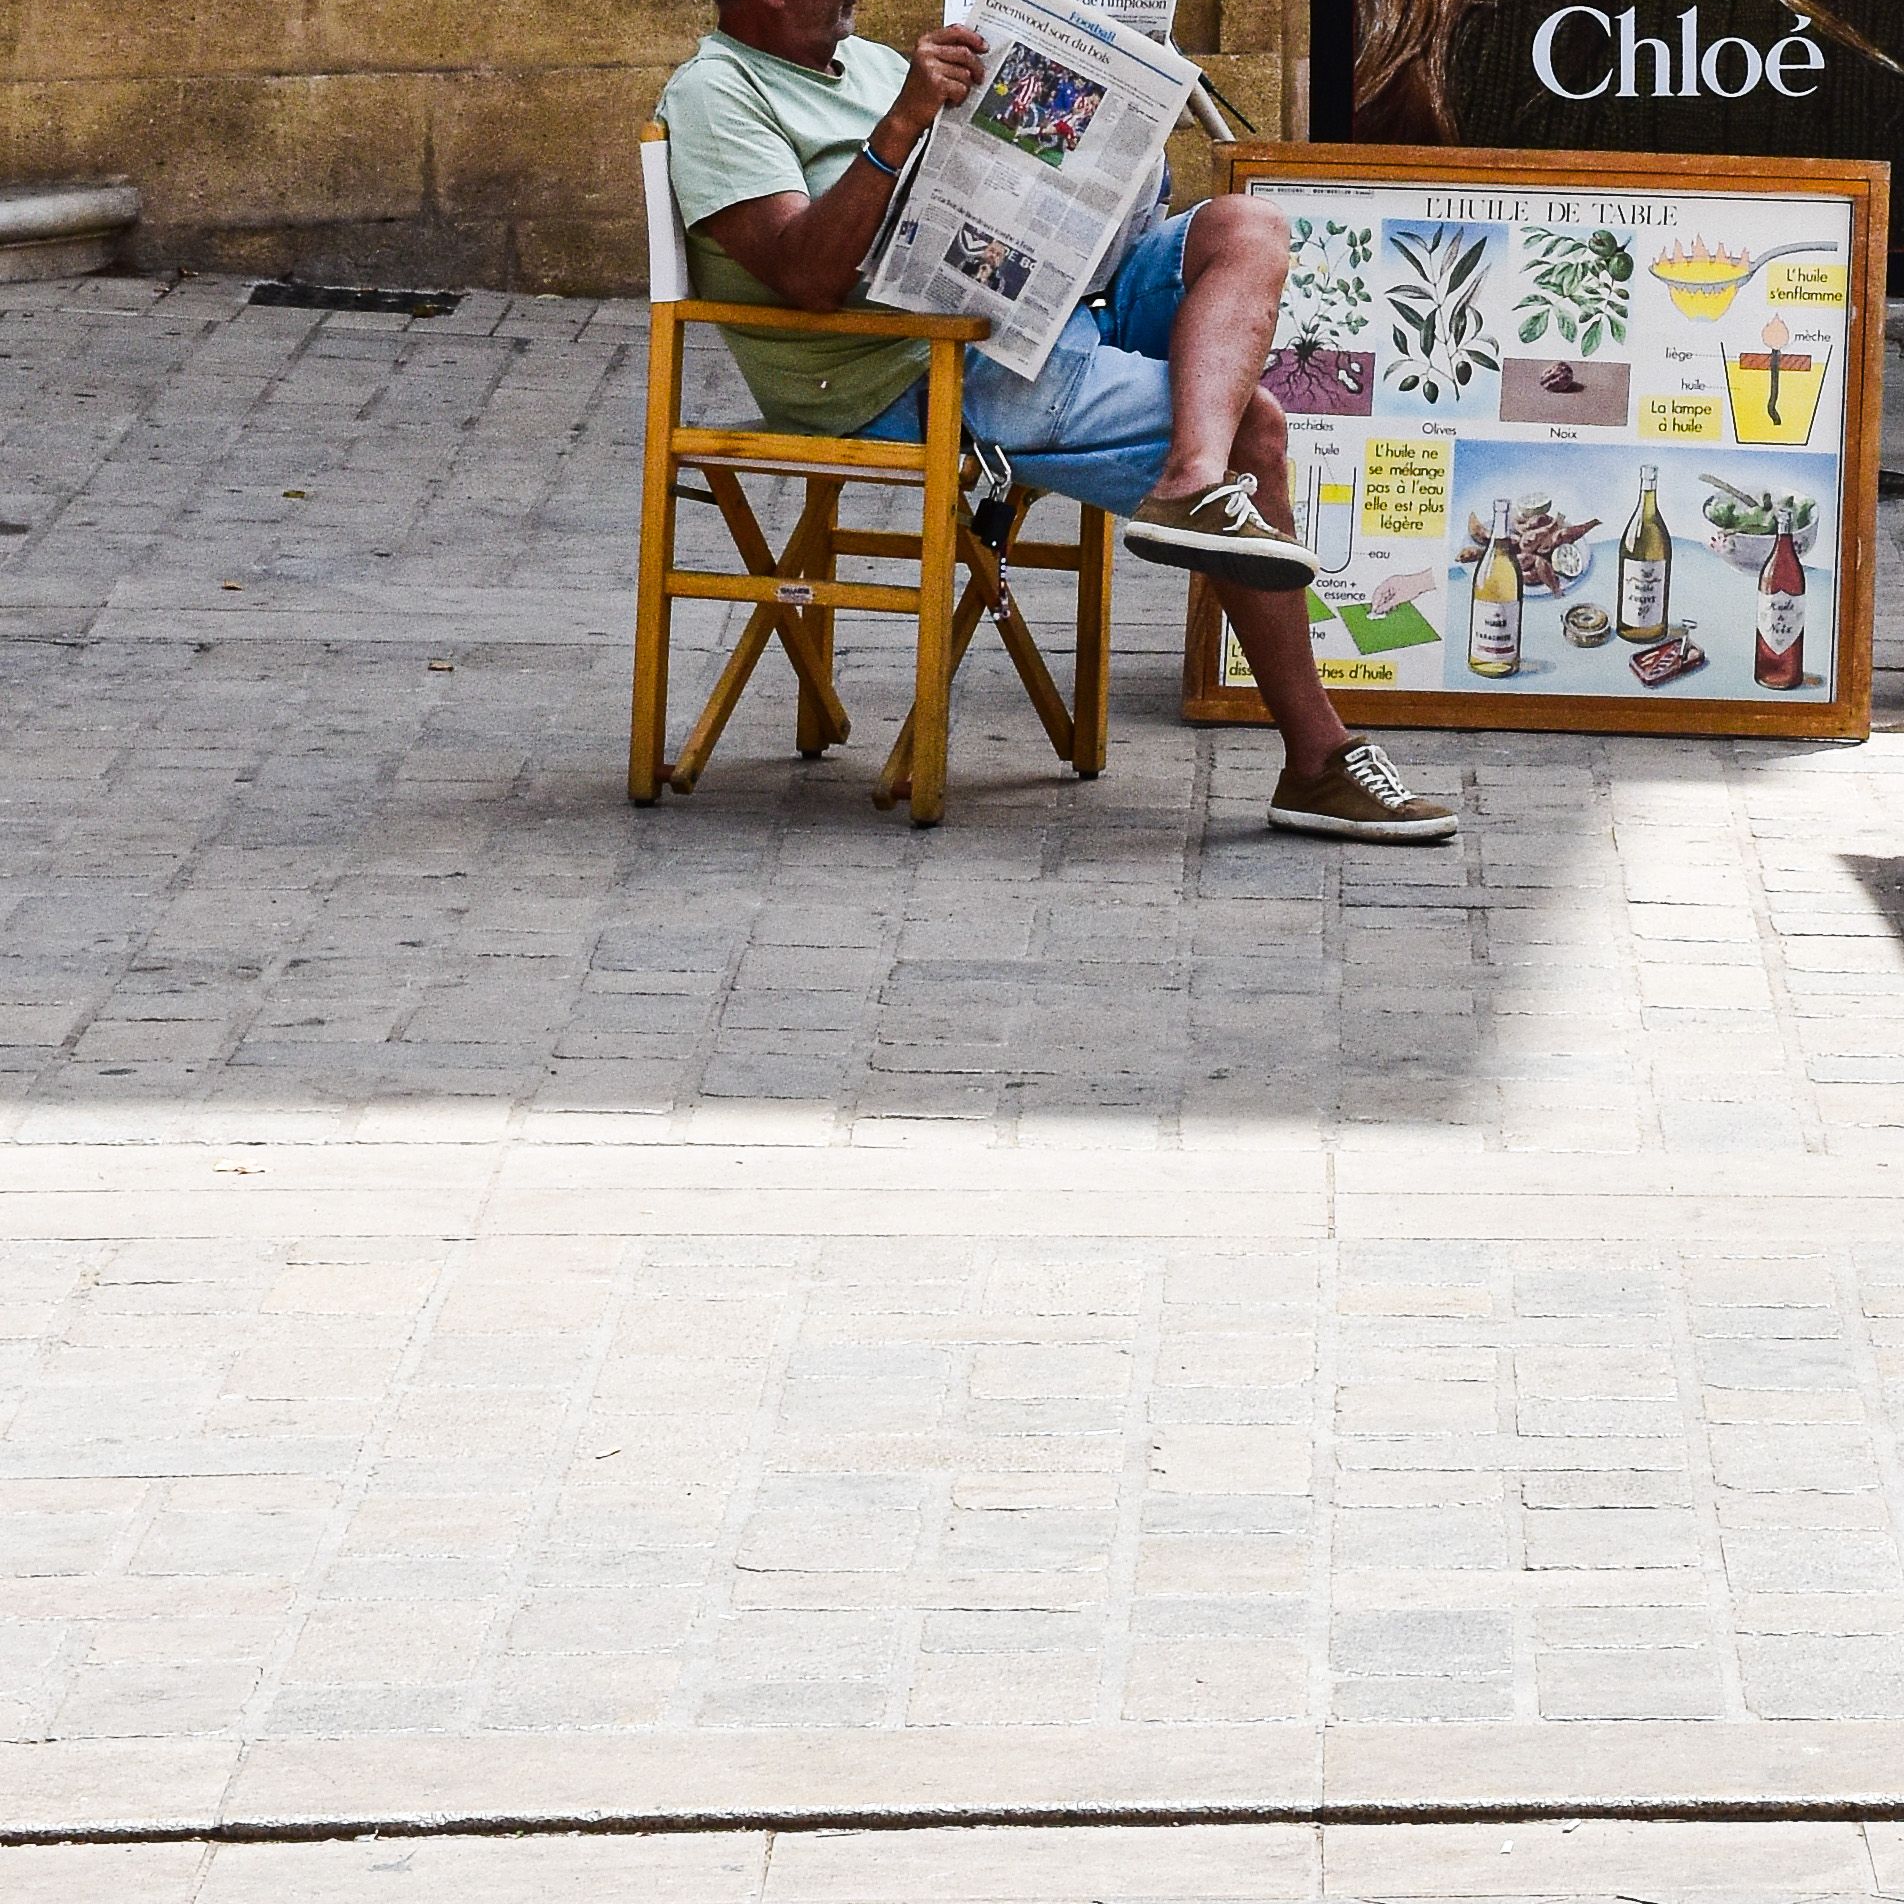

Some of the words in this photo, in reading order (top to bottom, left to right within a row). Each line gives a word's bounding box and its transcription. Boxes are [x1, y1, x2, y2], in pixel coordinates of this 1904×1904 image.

[1069, 11, 1117, 42] Football
[1050, 26, 1071, 44] sort
[1070, 35, 1088, 53] du
[1087, 43, 1112, 66] bois
[1531, 5, 1825, 100] Chloé
[1425, 196, 1530, 222] L'HUILE
[1547, 202, 1581, 224] DE
[1592, 203, 1679, 227] TABLE
[1787, 268, 1829, 284] L'huile
[1770, 286, 1844, 303] s'enflamme
[1794, 330, 1832, 343] mèche
[1665, 346, 1694, 363] liège
[1681, 378, 1706, 391] huile
[1651, 400, 1667, 414] La
[1671, 400, 1713, 417] lampe
[1421, 421, 1457, 436] Olives
[1549, 427, 1578, 440] Noix
[1658, 417, 1667, 433] à
[1672, 418, 1704, 434] huile
[1314, 443, 1340, 456] huile
[1375, 444, 1416, 459] L'huile
[1421, 449, 1439, 460] ne
[1368, 465, 1384, 476] se
[1389, 460, 1445, 481] mélange
[1366, 482, 1391, 497] pas
[1398, 479, 1407, 494] à
[1411, 479, 1444, 495] l'eau
[1364, 497, 1388, 511] elle
[1394, 499, 1413, 512] est
[1418, 499, 1445, 515] plus
[1380, 515, 1425, 534] légère
[1368, 549, 1391, 560] eau
[1316, 578, 1348, 589] coton
[1323, 591, 1366, 601] essence
[1349, 662, 1394, 681] d'huile
